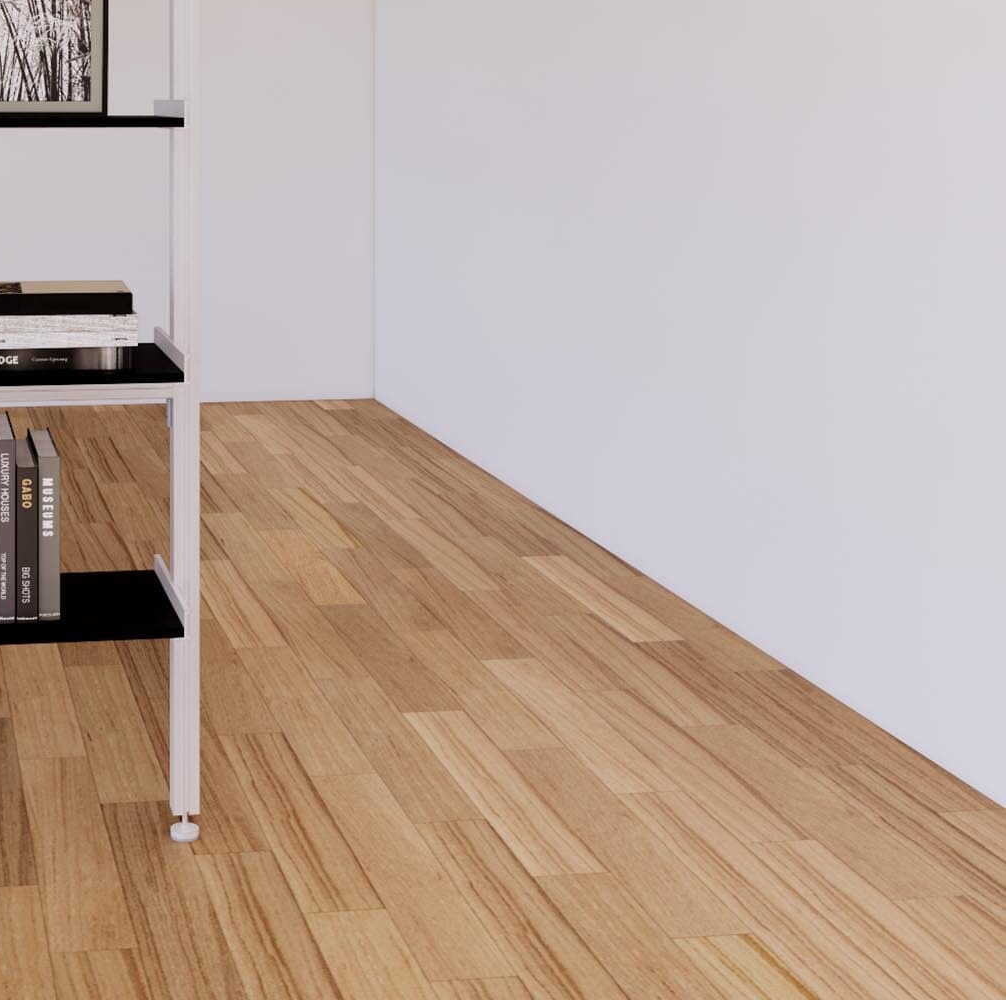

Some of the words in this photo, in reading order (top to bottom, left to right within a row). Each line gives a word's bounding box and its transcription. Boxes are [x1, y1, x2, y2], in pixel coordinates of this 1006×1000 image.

[0, 453, 9, 486] LUXURY
[0, 488, 9, 523] HOUSES
[22, 479, 32, 508] GABO
[42, 478, 53, 537] MUSEUMS
[22, 567, 31, 579] BIG
[22, 581, 31, 603] SHOTS
